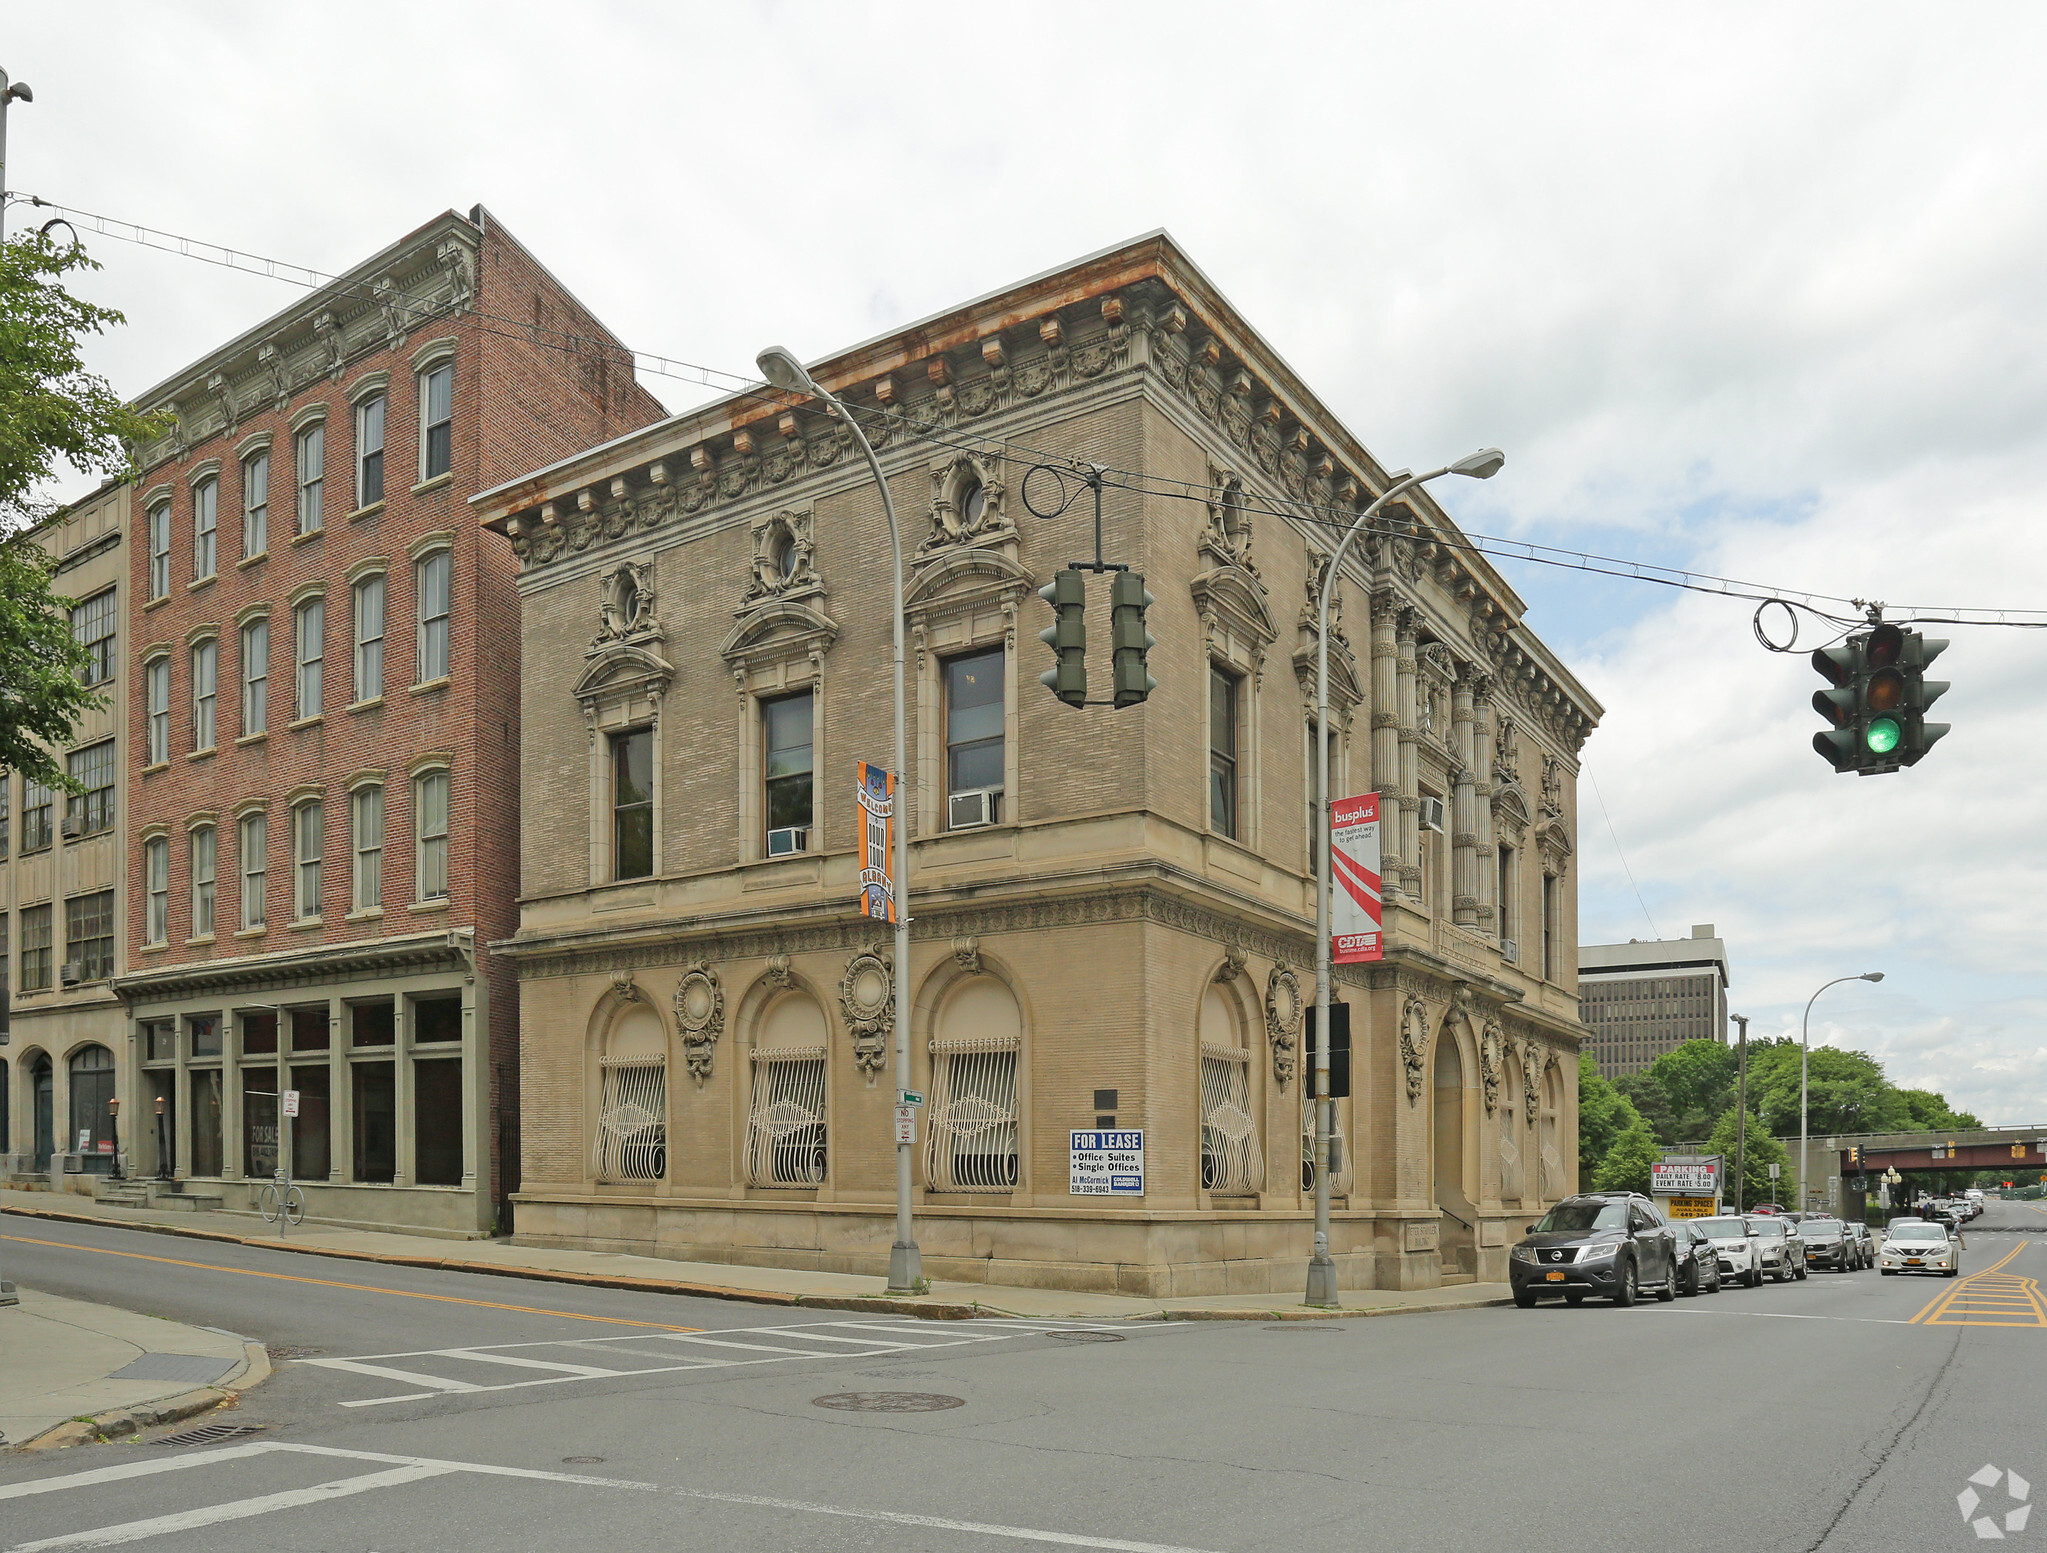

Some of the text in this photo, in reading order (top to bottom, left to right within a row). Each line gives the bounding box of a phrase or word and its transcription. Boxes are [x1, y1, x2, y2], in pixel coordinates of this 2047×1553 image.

[861, 792, 892, 815] WELCOME
[1335, 806, 1374, 824] busplus
[1346, 835, 1354, 843] get
[863, 871, 892, 894] ALBANY
[252, 1125, 264, 1142] FOR
[1074, 1134, 1139, 1149] FOR LEASE
[1078, 1153, 1136, 1161] Office Suites
[1078, 1163, 1140, 1173] Single Offices
[1660, 1165, 1708, 1173] PARKING
[1080, 1176, 1109, 1184] McCormick
[1694, 1200, 1713, 1208] SPACES
